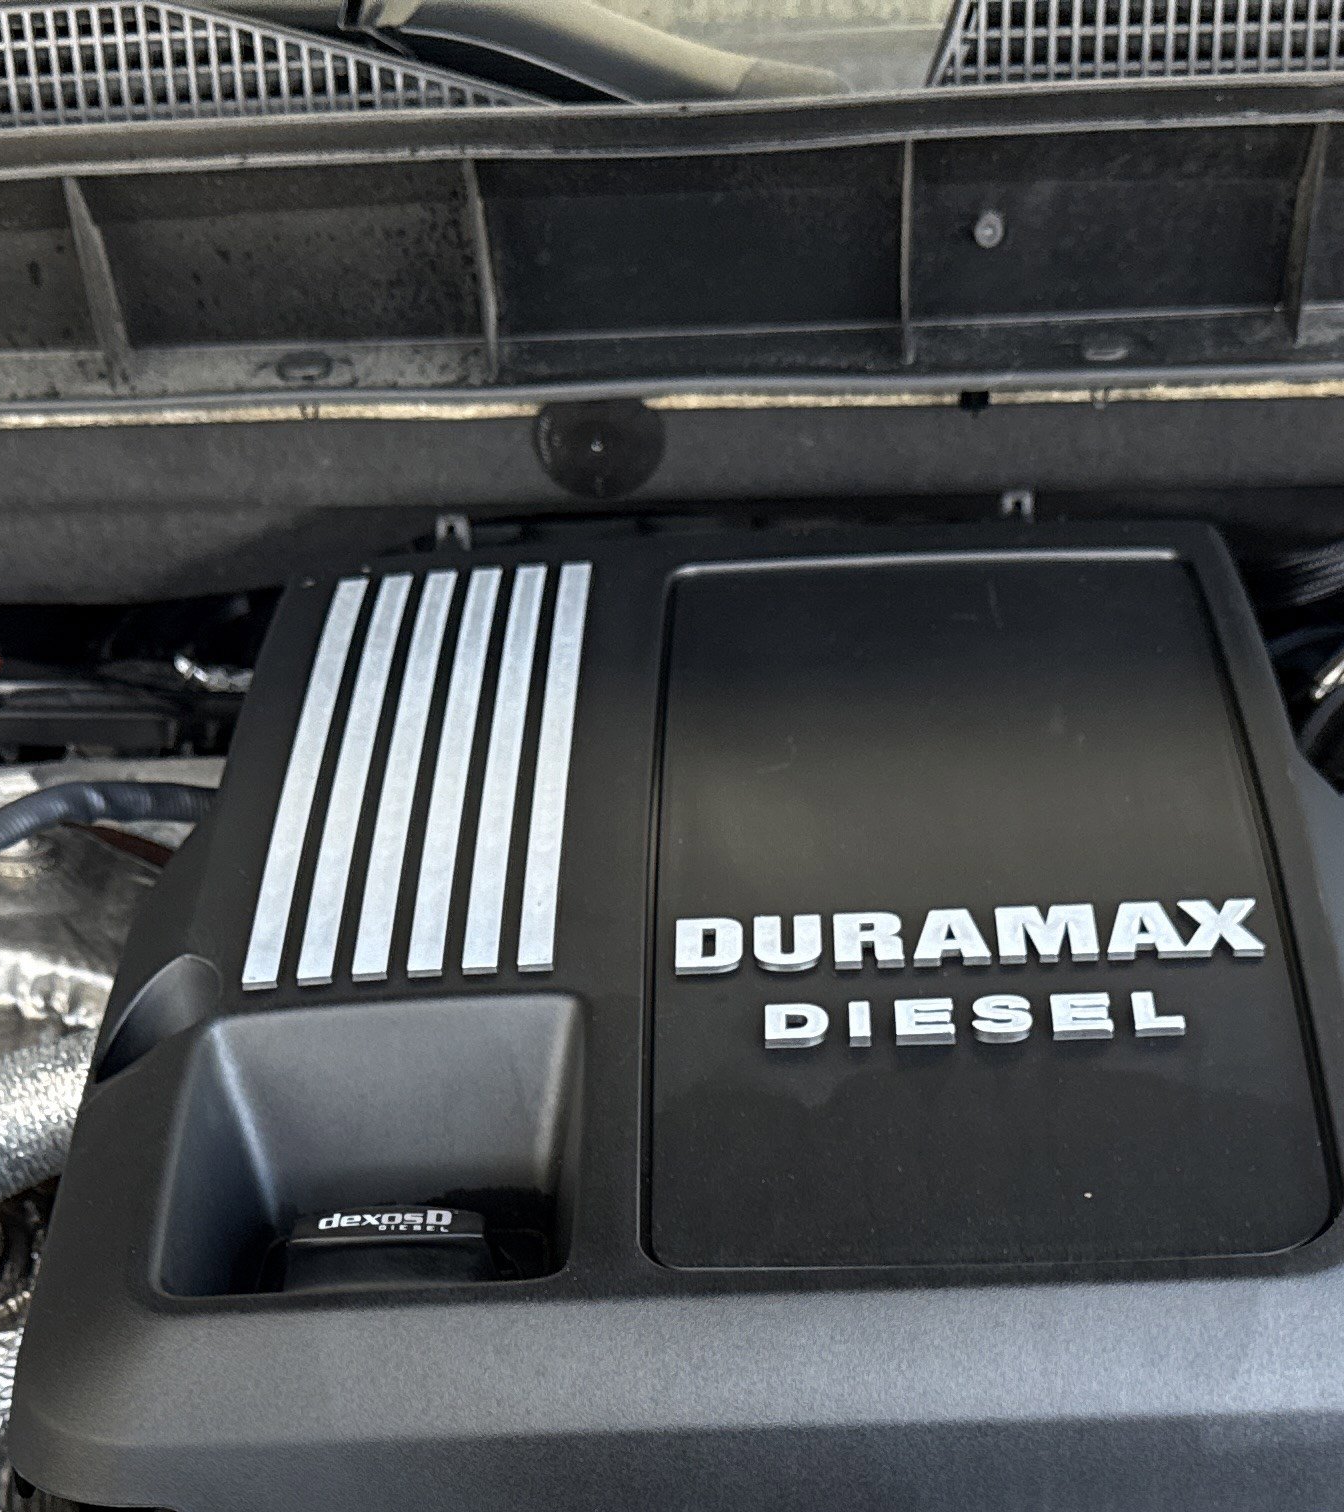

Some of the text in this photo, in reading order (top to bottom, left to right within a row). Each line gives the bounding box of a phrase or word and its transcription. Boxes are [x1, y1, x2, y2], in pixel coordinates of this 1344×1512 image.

[674, 898, 1265, 975] DURAMAX
[764, 990, 1186, 1049] DIESEL
[318, 1209, 453, 1230] dexosD
[378, 1224, 449, 1233] DIESEL
